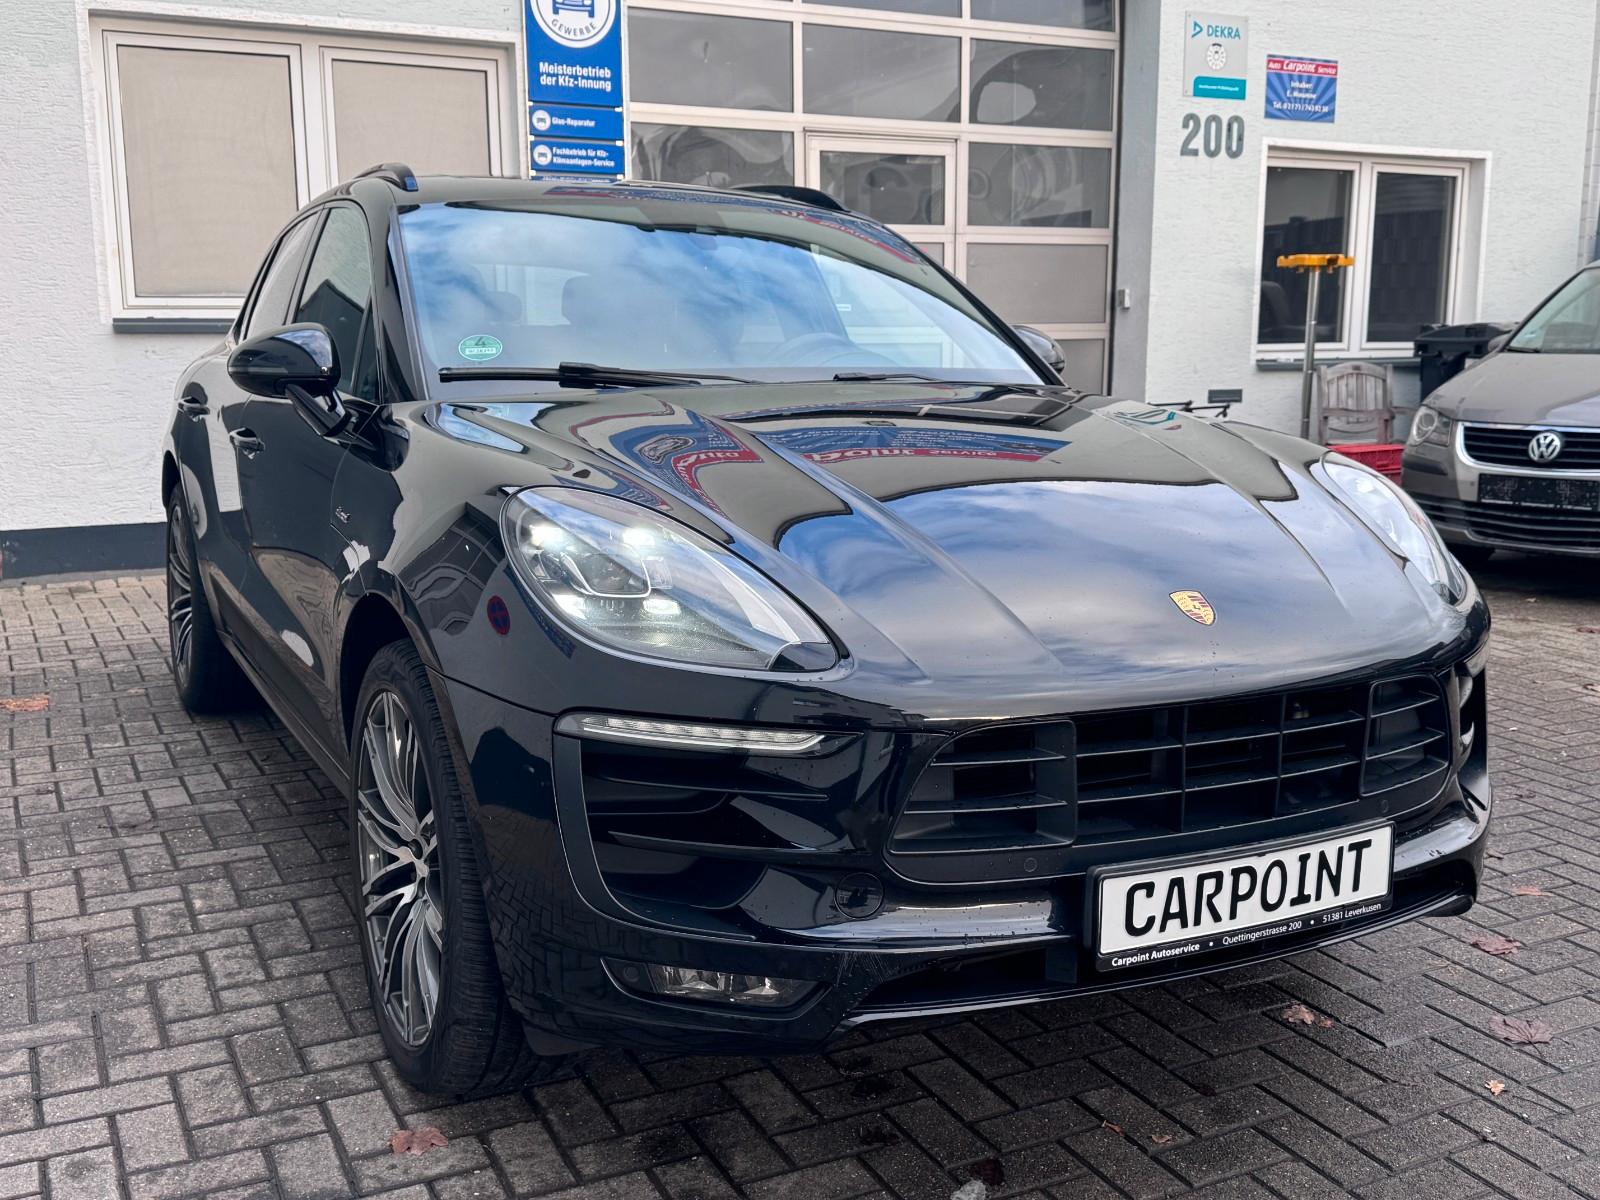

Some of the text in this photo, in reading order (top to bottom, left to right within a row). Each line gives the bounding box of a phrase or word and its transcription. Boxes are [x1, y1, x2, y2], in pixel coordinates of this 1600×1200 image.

[551, 18, 597, 36] GEWERBE
[1207, 24, 1241, 40] DEKRA
[539, 61, 611, 78] Meisterbetrieb
[1283, 60, 1316, 73] Carpoint
[540, 74, 611, 92] der Kfz-Innung
[1180, 112, 1245, 159] 200
[552, 146, 587, 156] Fachbetrieb
[552, 156, 615, 168] Klimaanlagen-Service
[1124, 838, 1372, 937] CARPOINT
[1111, 903, 1382, 967] Carpoint Autoservice Quettingerstrasse 200 51381 Leverkusen
